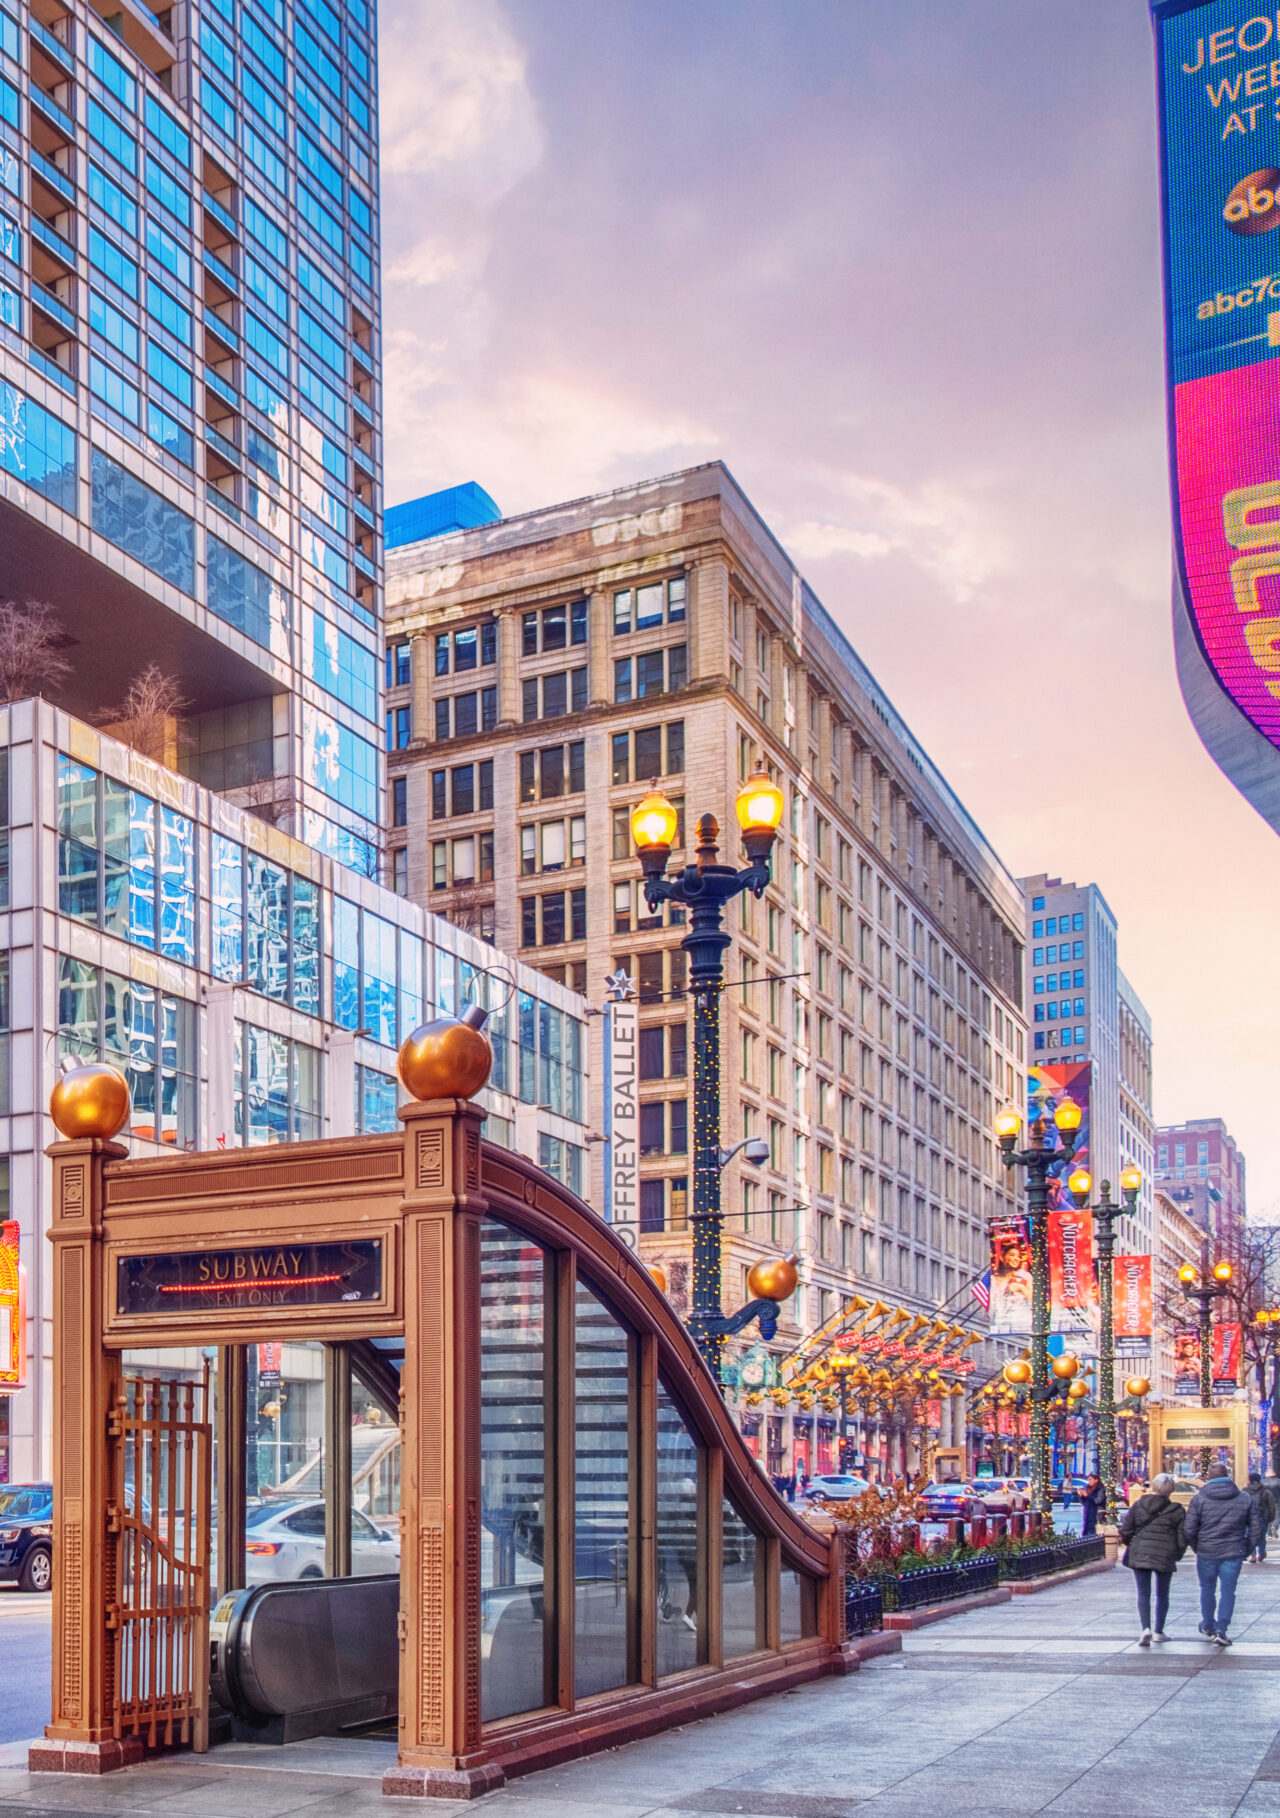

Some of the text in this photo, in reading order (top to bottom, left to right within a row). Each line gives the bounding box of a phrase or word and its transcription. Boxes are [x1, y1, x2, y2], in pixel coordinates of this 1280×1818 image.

[1183, 10, 1280, 74] JEO
[1222, 103, 1264, 140] AT
[613, 1005, 636, 1250] OFFREY BALLET
[200, 1251, 303, 1281] SUBWAY
[1059, 1218, 1079, 1301] NUTCRACKER
[217, 1289, 288, 1307] EXIT ONLY
